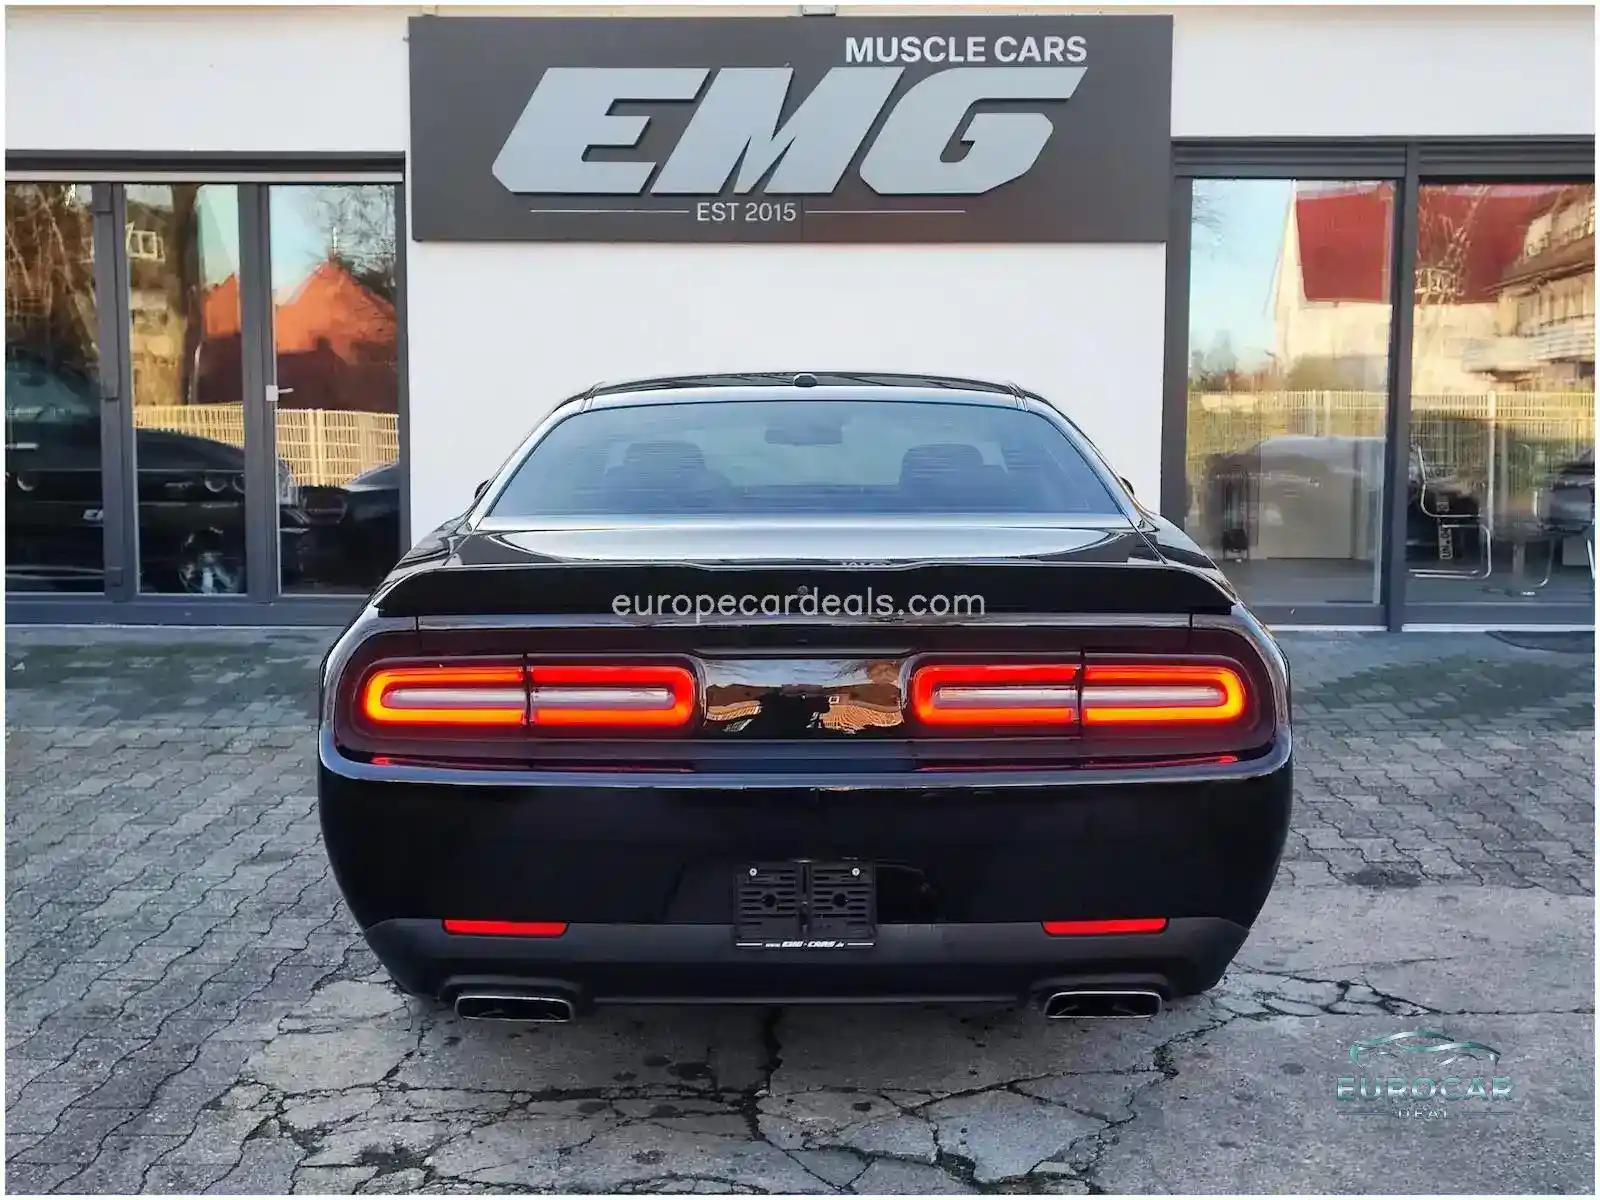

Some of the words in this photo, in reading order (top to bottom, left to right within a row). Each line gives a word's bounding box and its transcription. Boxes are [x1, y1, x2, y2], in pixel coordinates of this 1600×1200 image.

[845, 36, 986, 63] MUSCLE
[994, 36, 1088, 63] CARS
[492, 66, 1088, 195] EMG
[697, 202, 740, 221] EST
[744, 202, 797, 222] 2015
